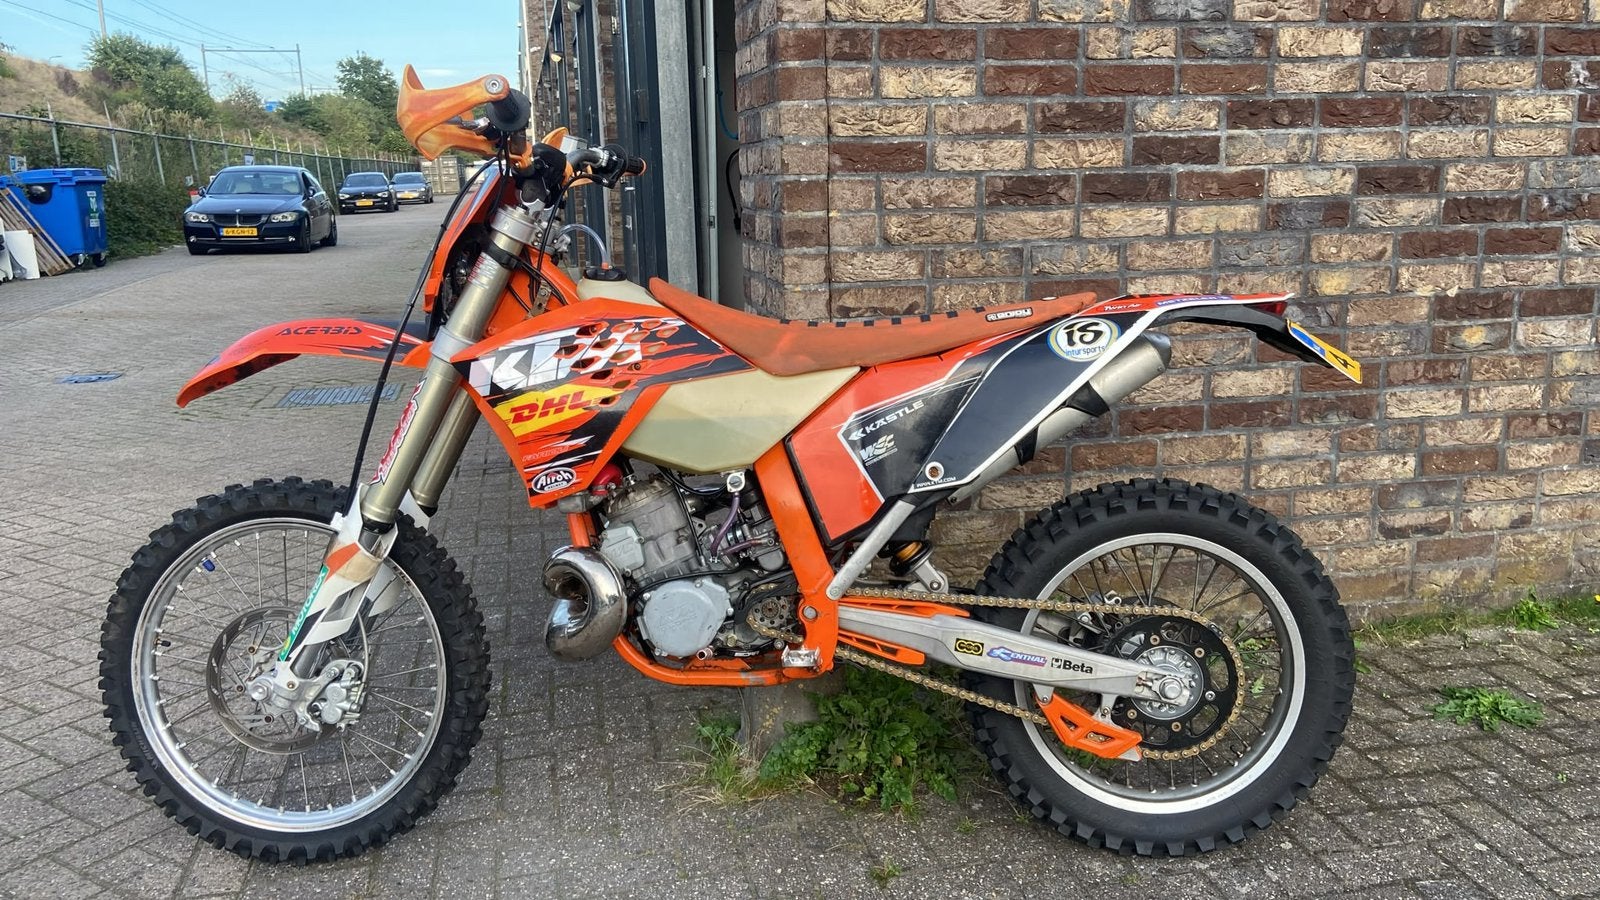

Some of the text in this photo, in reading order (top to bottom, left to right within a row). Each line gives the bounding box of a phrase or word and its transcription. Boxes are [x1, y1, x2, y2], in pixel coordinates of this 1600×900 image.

[275, 326, 362, 336] ACERBIS
[1065, 345, 1106, 356] intursports
[509, 390, 592, 424] DHL
[536, 470, 573, 489] Airoh
[291, 571, 325, 635] MOTOREX
[1061, 659, 1094, 674] Beta
